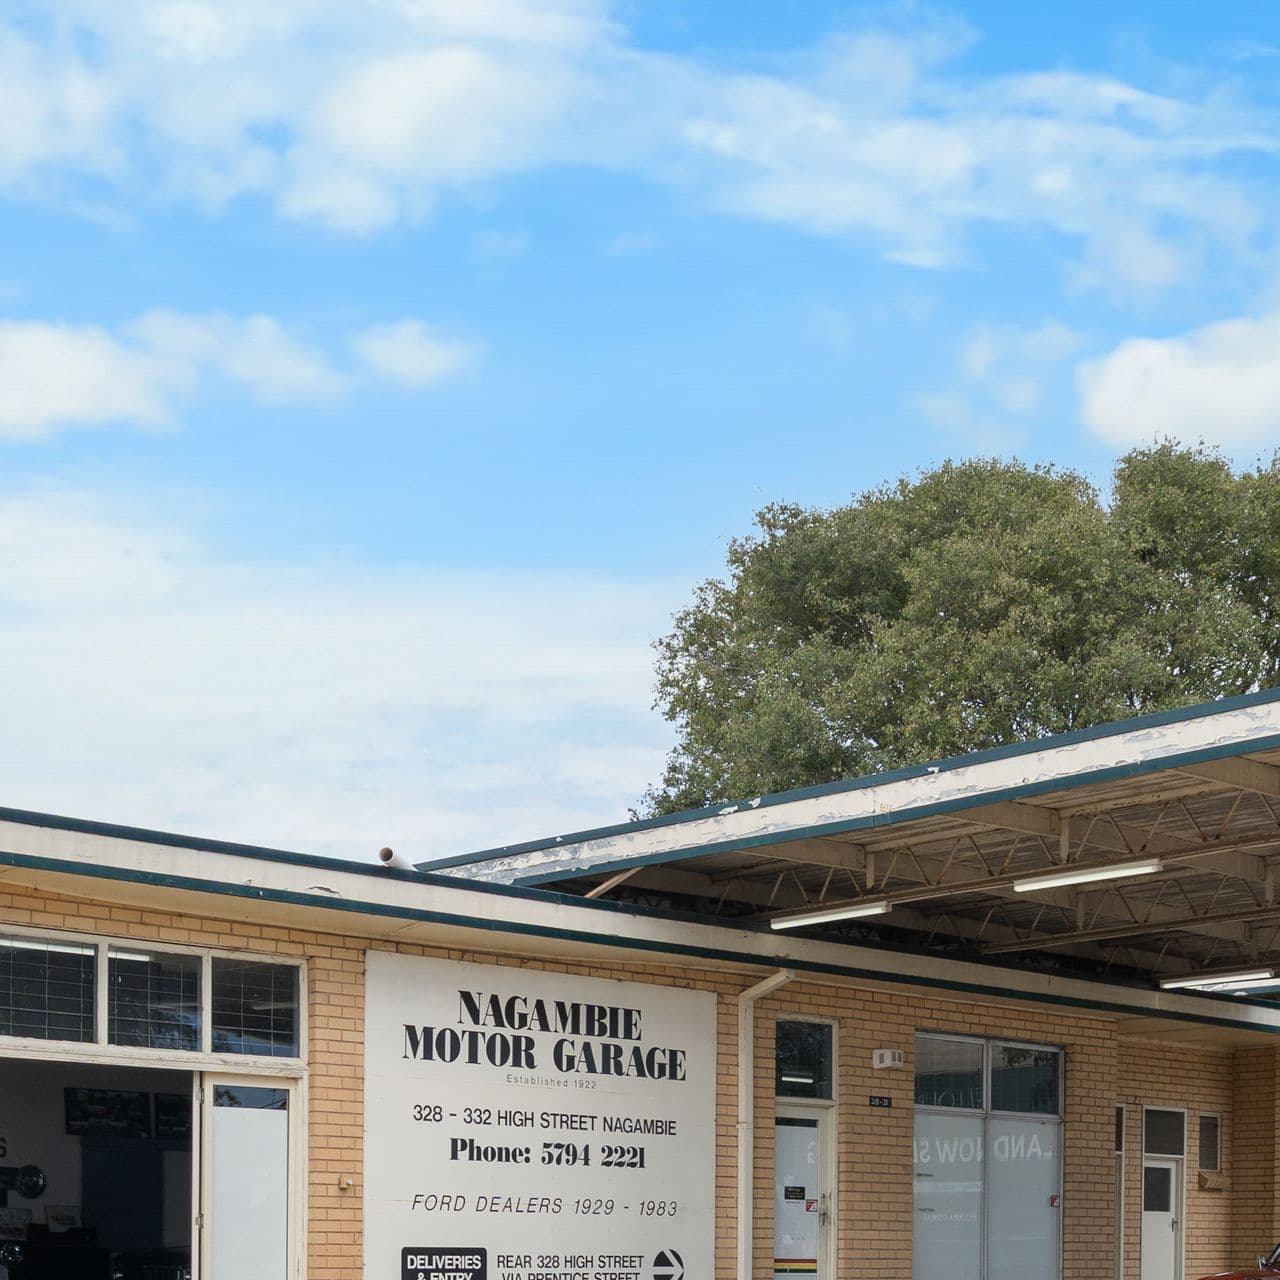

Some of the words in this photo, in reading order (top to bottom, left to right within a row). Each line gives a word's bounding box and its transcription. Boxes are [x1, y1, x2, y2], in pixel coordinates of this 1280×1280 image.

[457, 990, 642, 1041] NAGAMBIE
[402, 1024, 538, 1069] MOTOR
[553, 1038, 687, 1081] GARAGE
[506, 1073, 569, 1088] Established
[574, 1079, 597, 1090] 1922
[413, 1104, 443, 1122] 328
[463, 1107, 492, 1126] 332
[497, 1109, 535, 1128] HIGH
[540, 1111, 598, 1132] STREET
[603, 1116, 677, 1136] NAGAMBIE
[450, 1137, 531, 1164] Phone:
[540, 1142, 591, 1167] 5794
[600, 1144, 646, 1169] 2221
[412, 1194, 466, 1212] FORD
[475, 1195, 563, 1214] DEALERS
[575, 1198, 615, 1216] 1929
[639, 1200, 678, 1217] 1983
[406, 1254, 482, 1270] DELIVERIES
[497, 1254, 532, 1269] REAR
[536, 1254, 560, 1269] 328
[564, 1254, 594, 1269] HIGH
[597, 1254, 644, 1269] STREET
